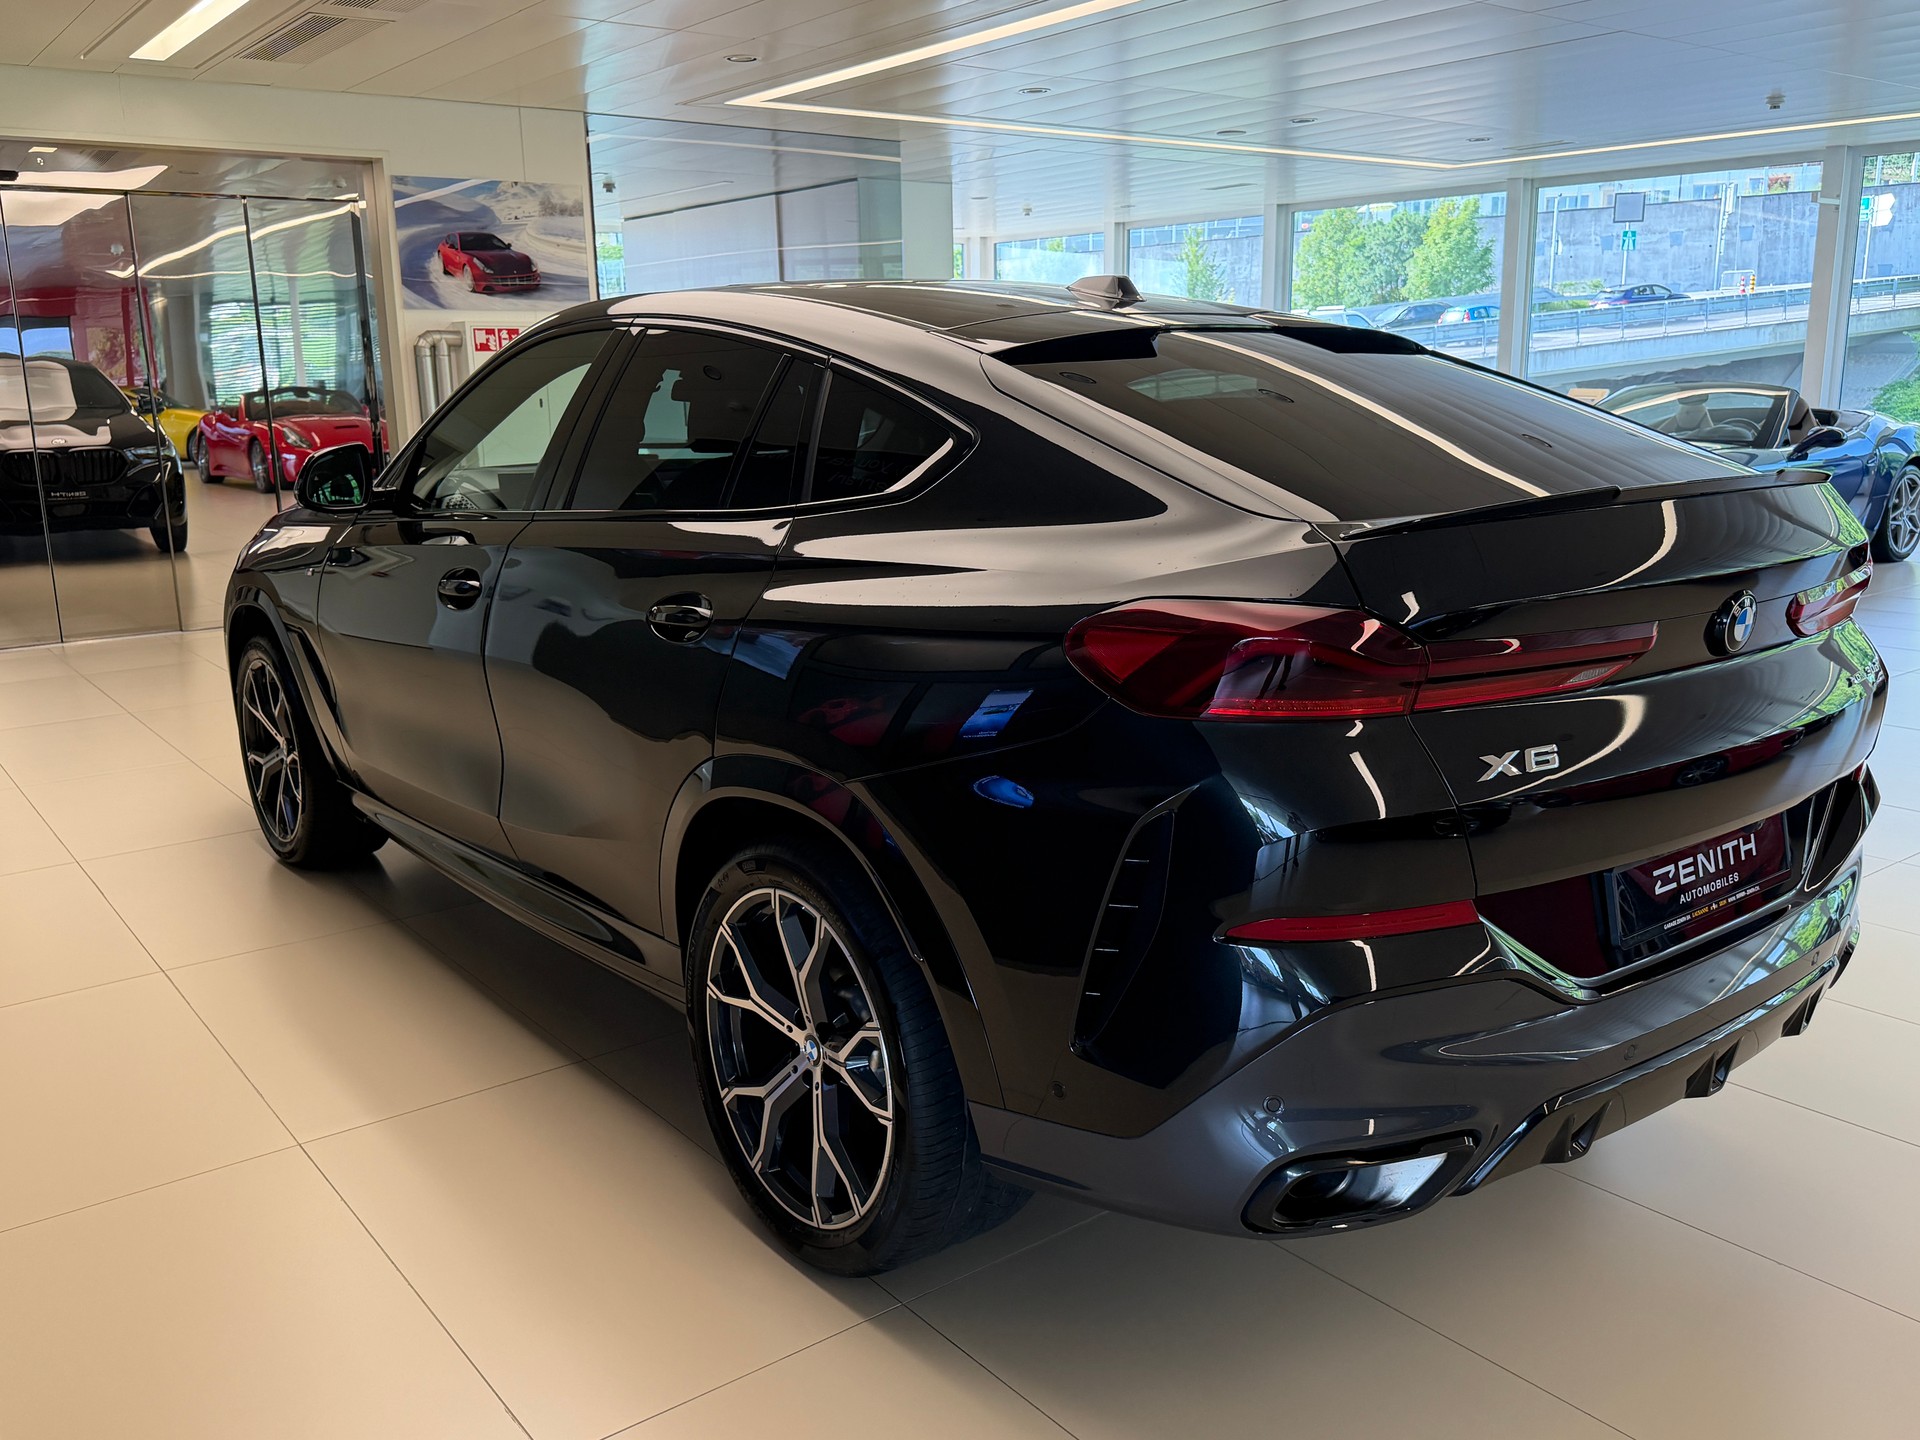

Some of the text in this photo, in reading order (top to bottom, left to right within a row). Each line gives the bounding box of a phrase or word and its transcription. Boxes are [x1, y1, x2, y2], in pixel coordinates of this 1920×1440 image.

[1477, 744, 1560, 782] X6
[1652, 833, 1757, 895] ZENITH
[1680, 872, 1740, 904] AUTOMOBILES
